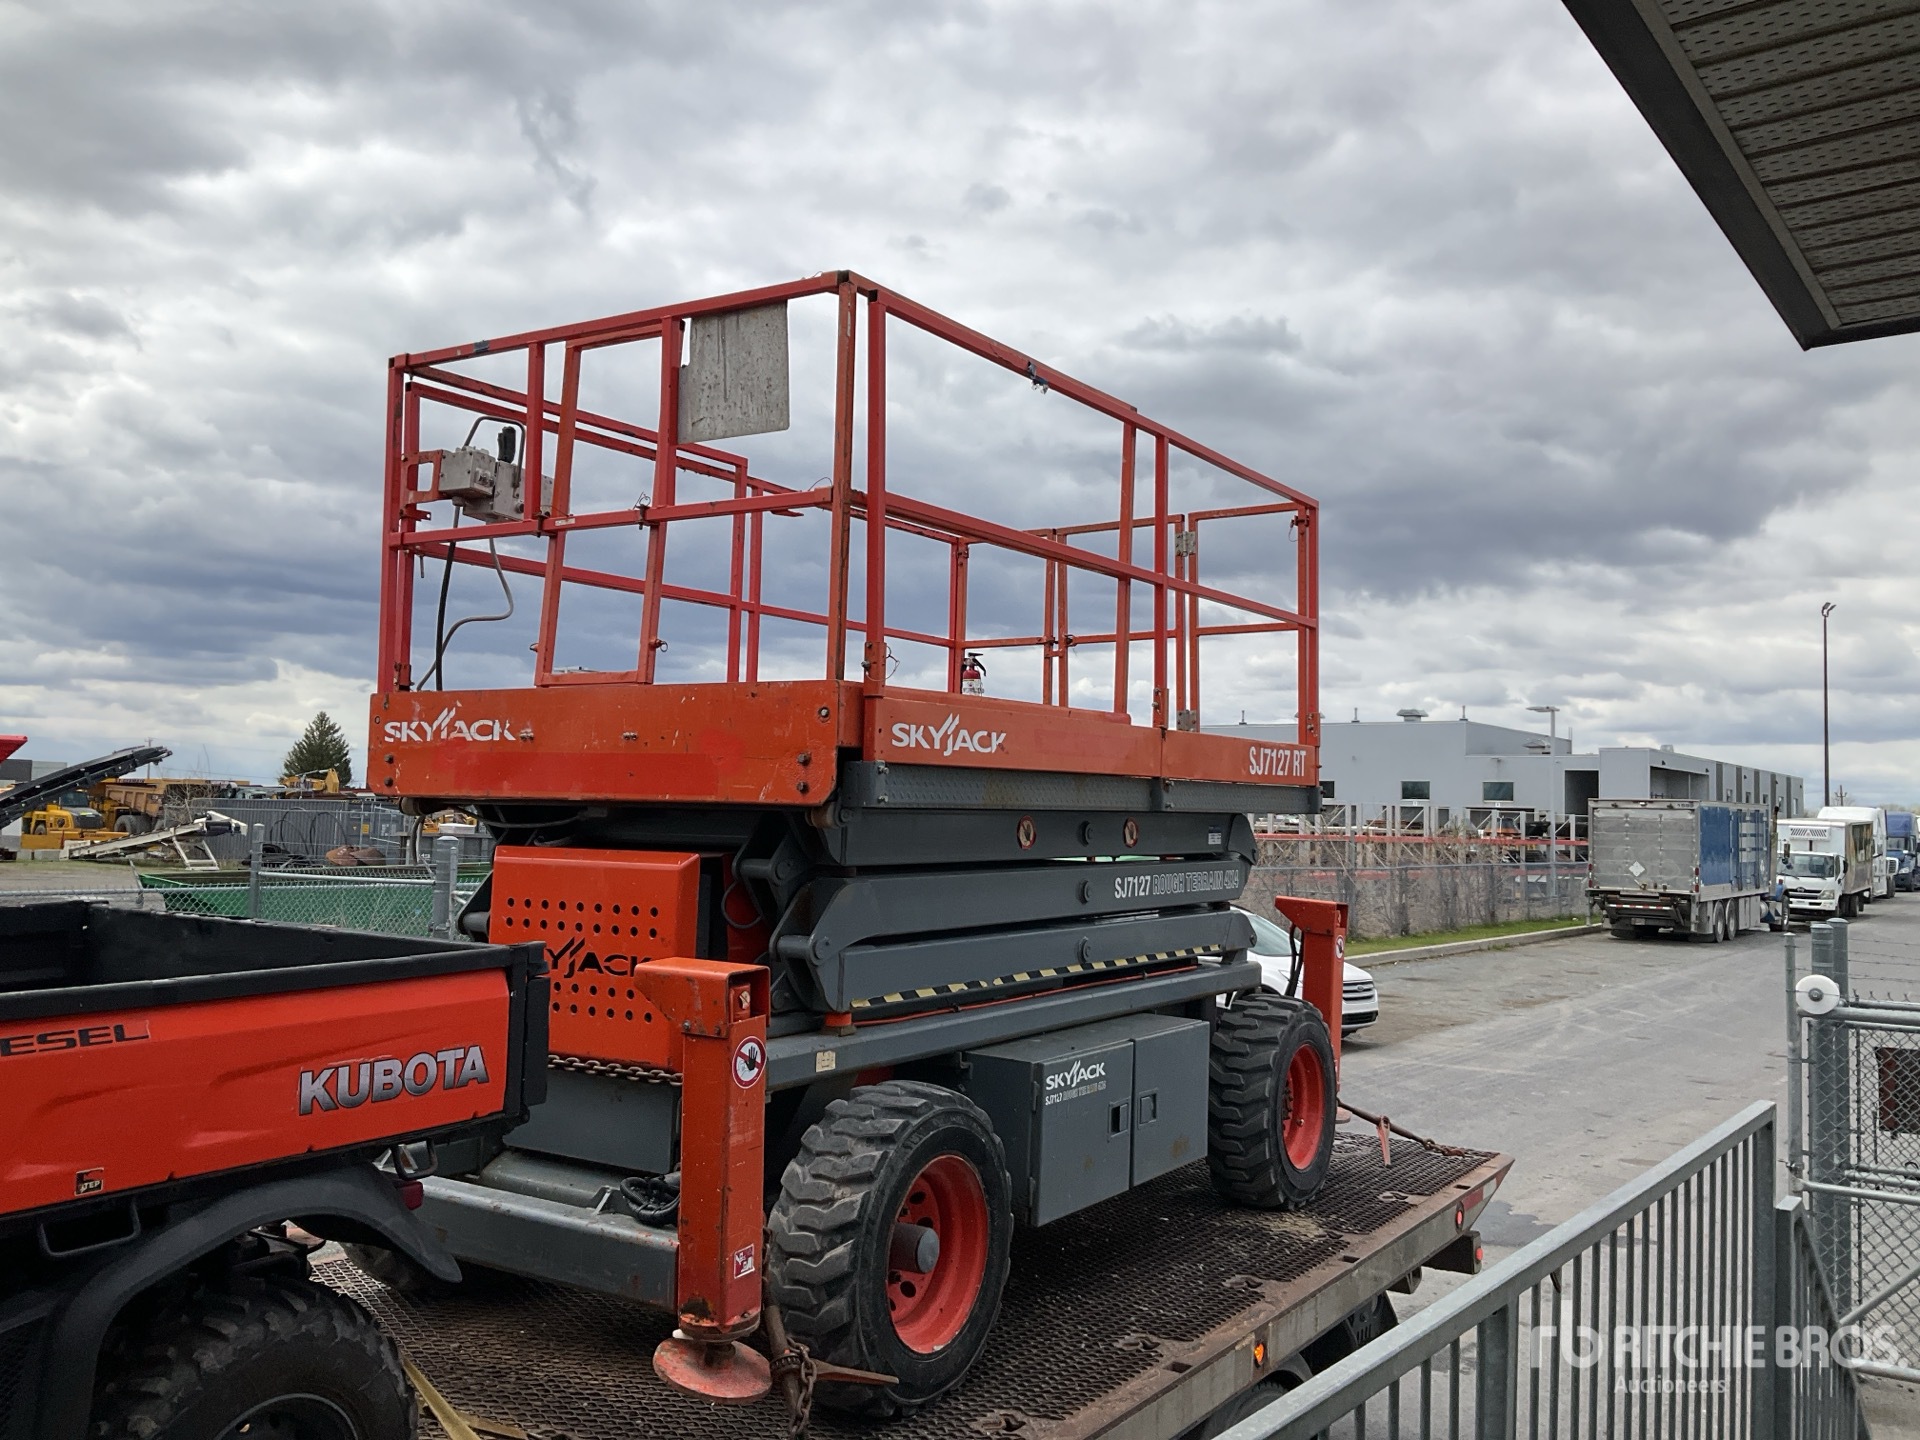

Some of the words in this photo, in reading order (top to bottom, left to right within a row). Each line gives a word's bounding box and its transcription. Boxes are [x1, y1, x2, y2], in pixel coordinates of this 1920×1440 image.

[891, 713, 1007, 757] SKYJACK
[1249, 746, 1291, 776] SJ7127
[1292, 749, 1307, 777] RT
[1114, 875, 1151, 899] SJ7127
[1152, 872, 1185, 895] ROUGH
[299, 1045, 489, 1116] KUBOTA
[1045, 1060, 1106, 1091] SKYJACK
